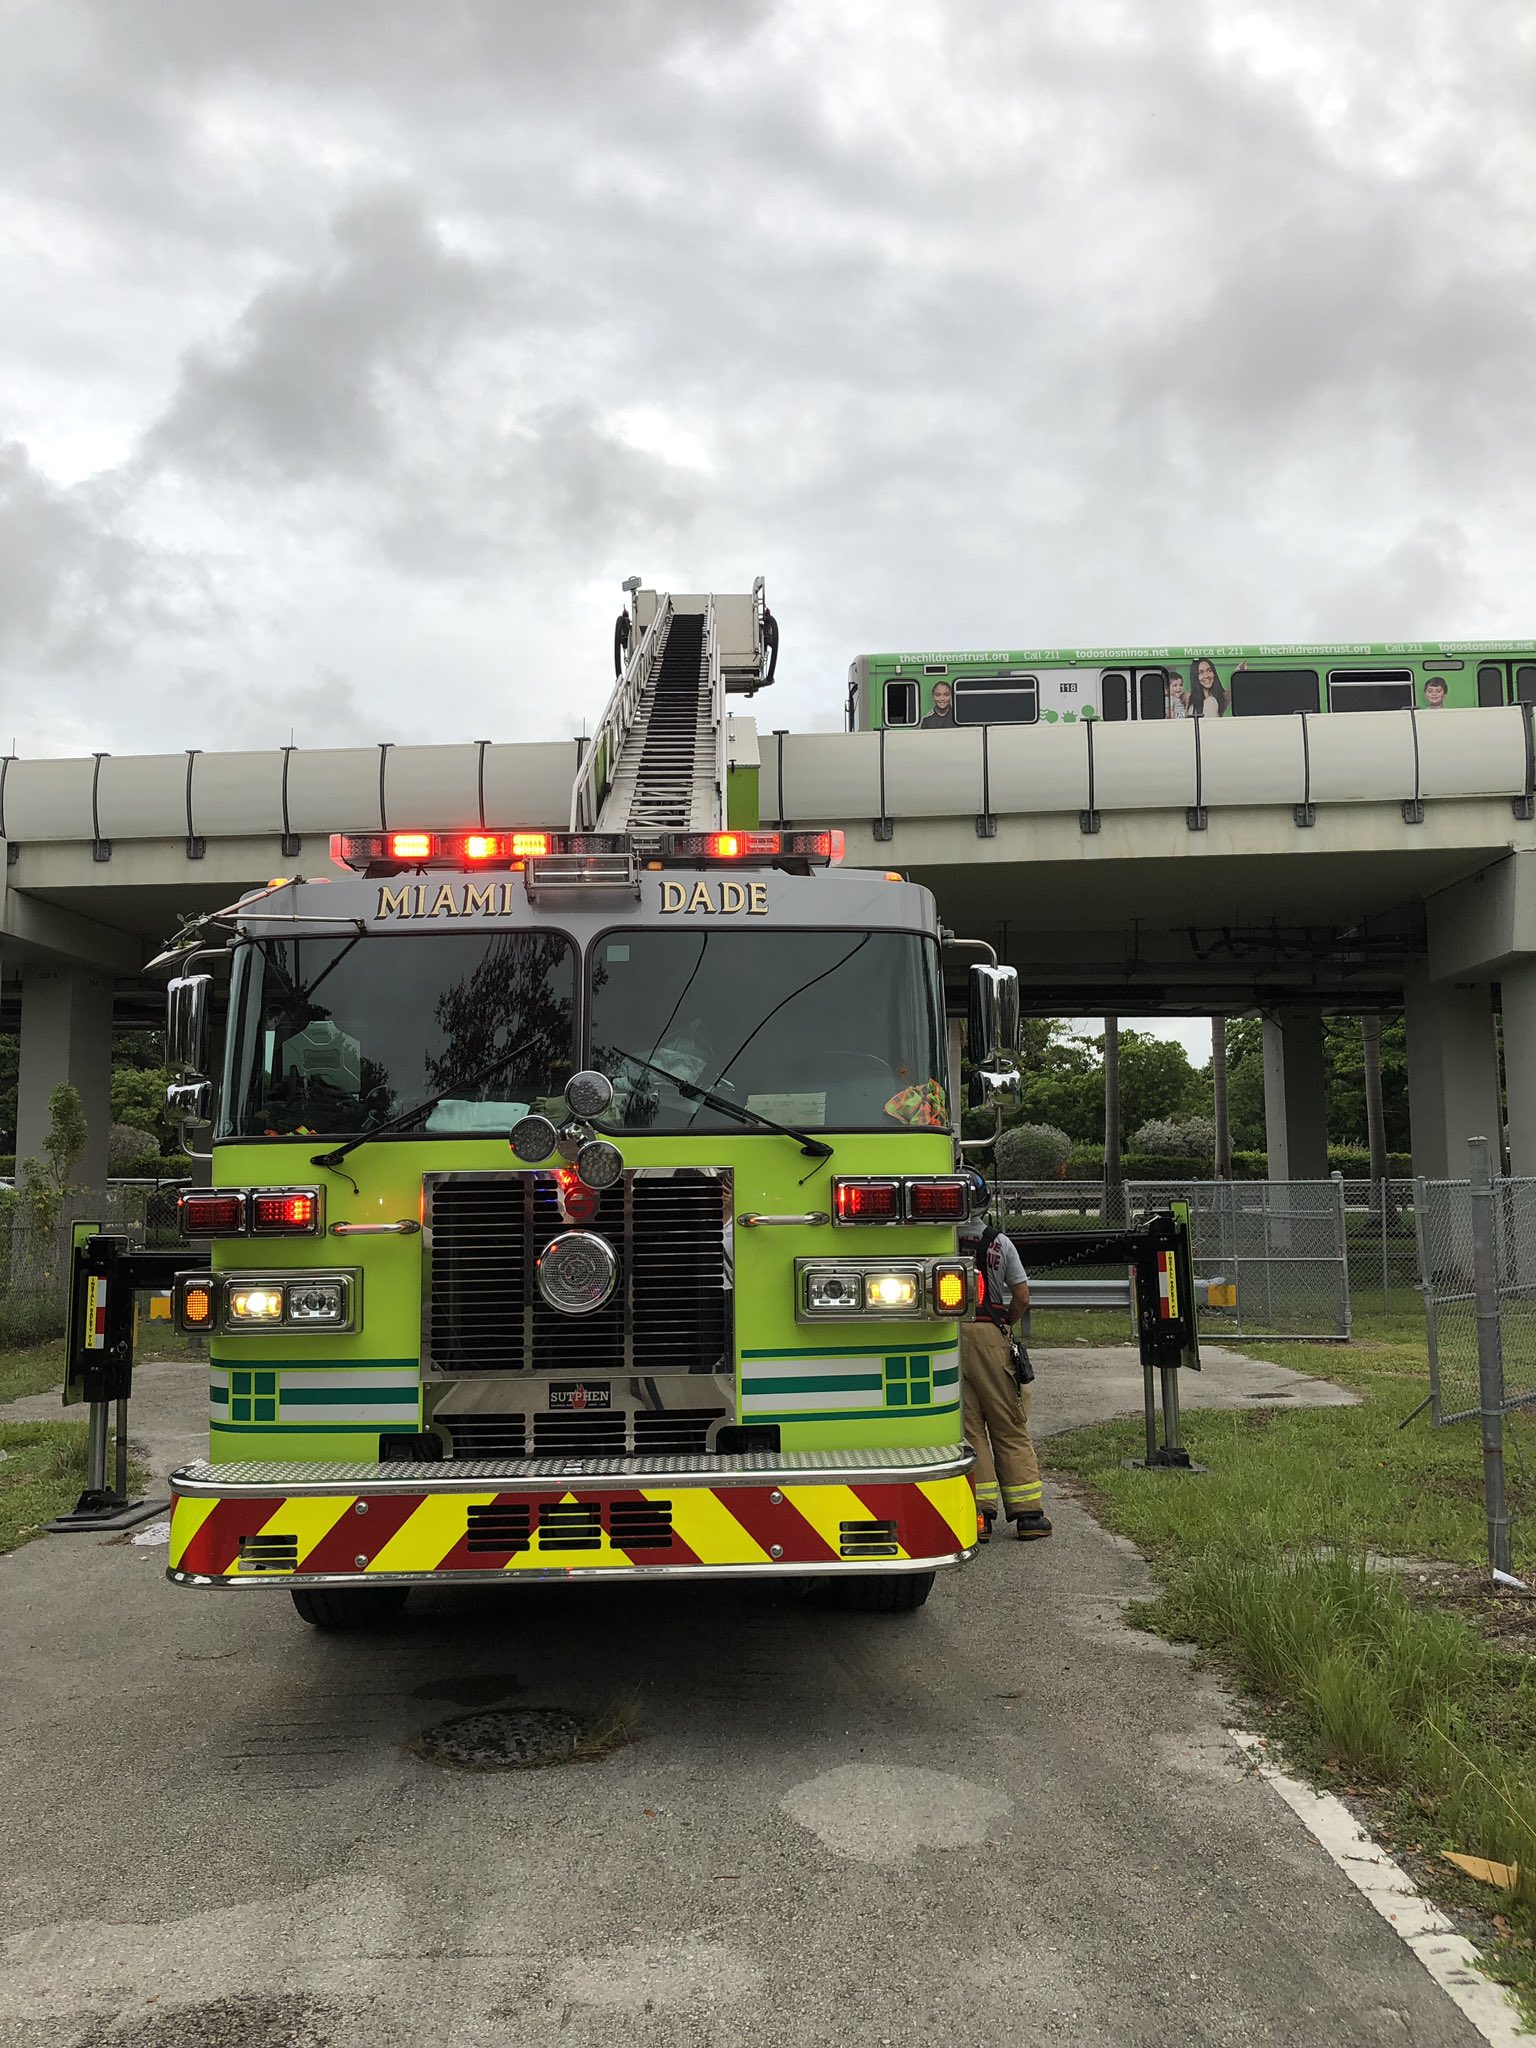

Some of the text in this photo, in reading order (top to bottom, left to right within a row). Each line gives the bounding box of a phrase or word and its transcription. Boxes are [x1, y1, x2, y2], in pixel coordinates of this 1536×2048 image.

[1259, 643, 1423, 655] thechildrenstrust.org Call 211
[1438, 641, 1535, 652] todoslosninos.net
[900, 651, 1061, 663] thechildrenstrust.org Call 211
[1075, 647, 1244, 659] todoslosninos.net Marca el 211
[1060, 683, 1077, 692] 118
[375, 881, 770, 920] MIAMI DADE
[550, 1391, 610, 1402] SUTPHEN
